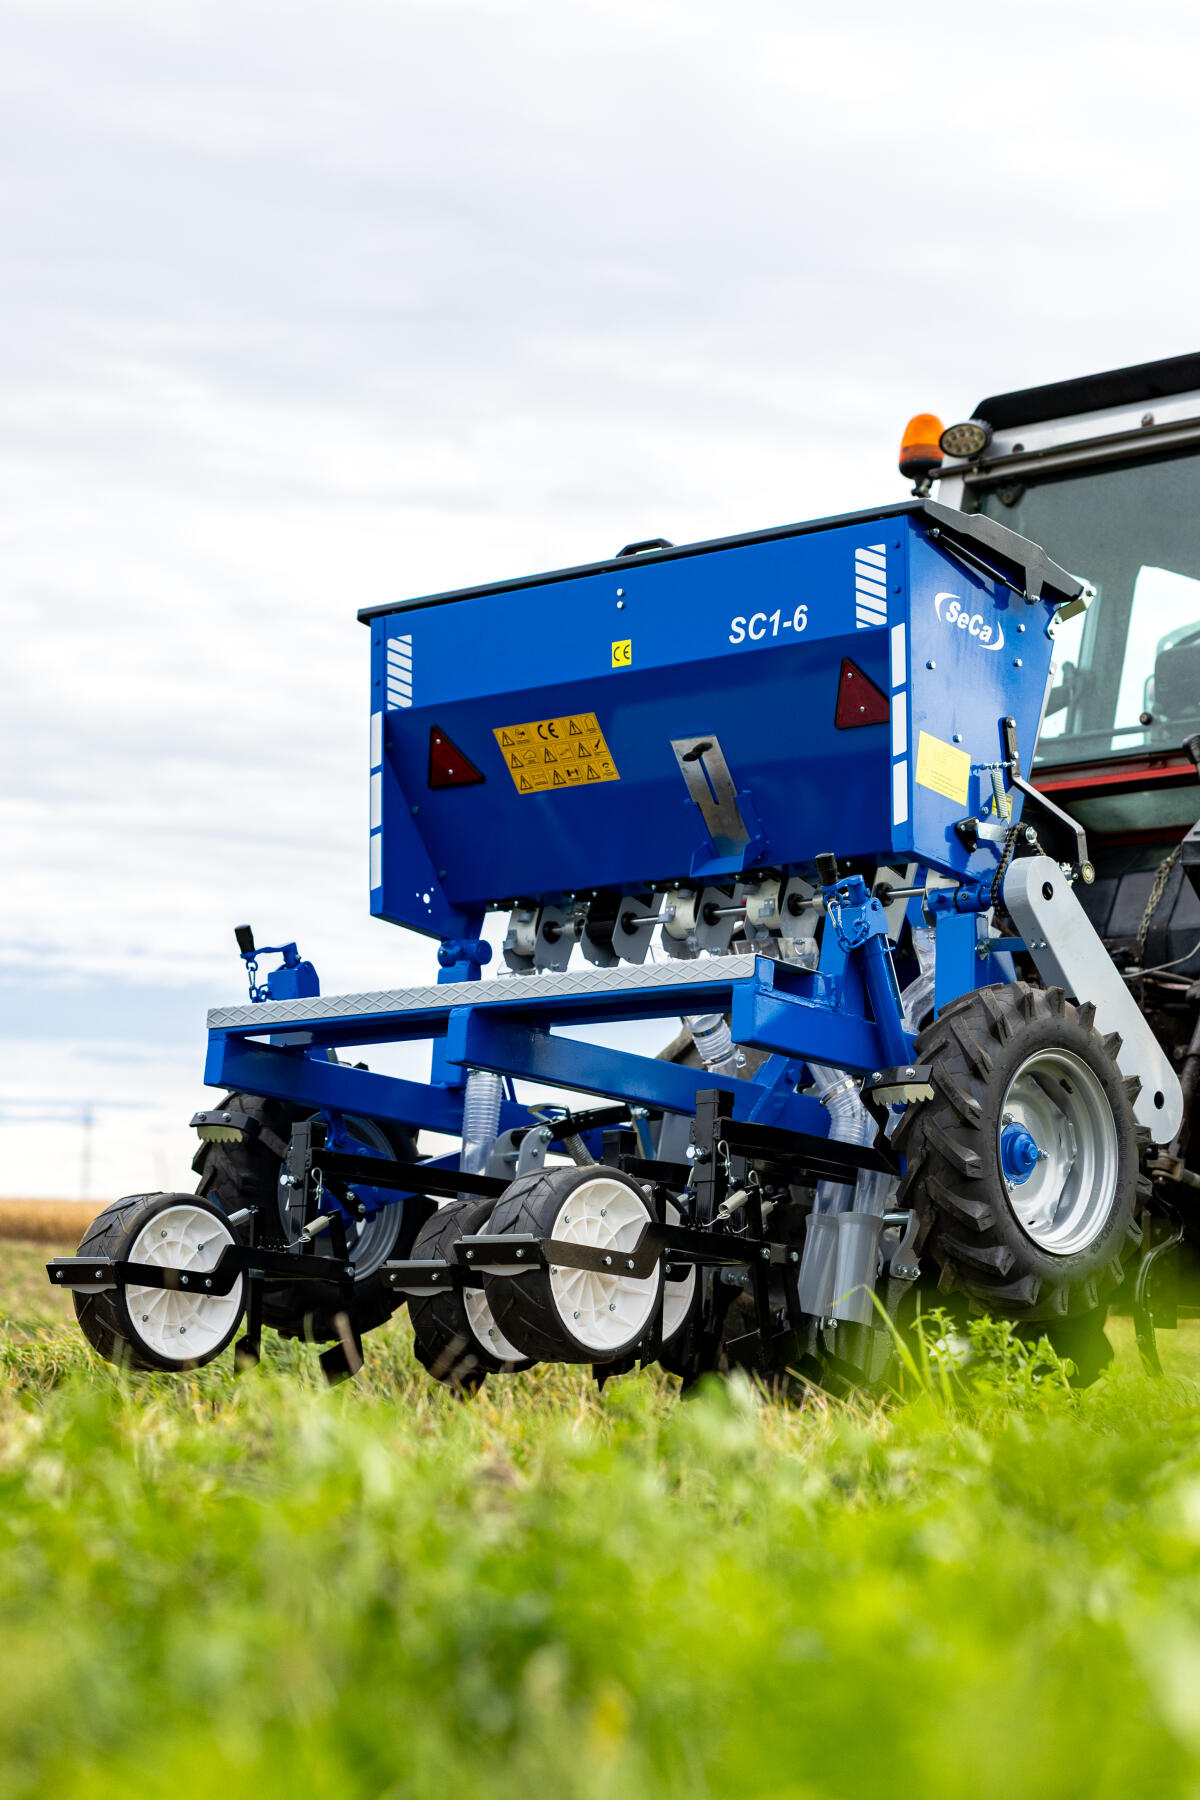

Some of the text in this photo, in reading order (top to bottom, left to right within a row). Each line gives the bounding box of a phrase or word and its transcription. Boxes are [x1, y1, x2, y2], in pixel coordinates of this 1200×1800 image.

[728, 604, 809, 644] SC1-6
[945, 601, 993, 643] SeCa
[613, 644, 630, 662] CE
[537, 722, 559, 740] CE
